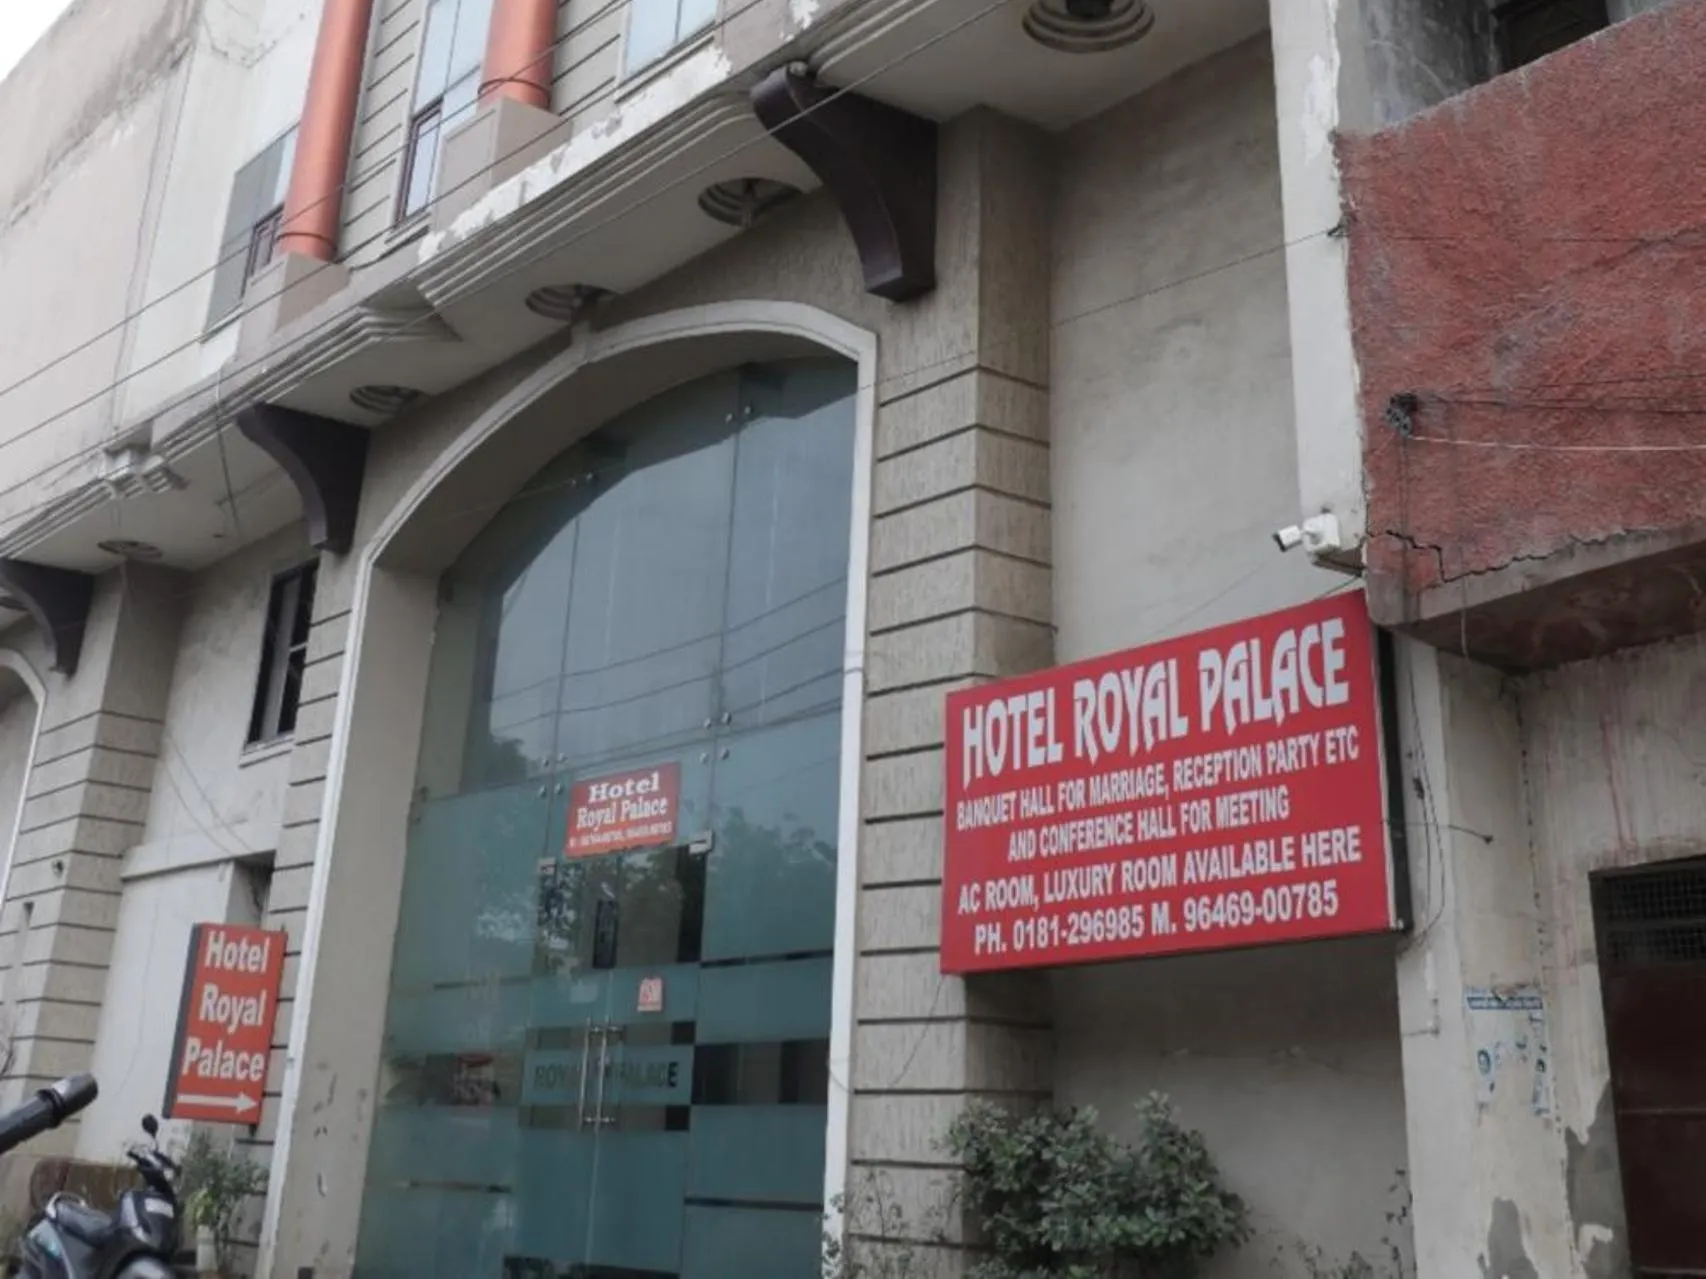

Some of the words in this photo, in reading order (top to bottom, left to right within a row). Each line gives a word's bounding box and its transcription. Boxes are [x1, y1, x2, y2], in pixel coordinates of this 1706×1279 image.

[962, 687, 1064, 790] HOTEL
[1073, 658, 1188, 766] ROYAL
[1199, 617, 1349, 736] PALACE
[588, 771, 660, 804] Hotel
[956, 790, 1017, 831] BANQUET
[1020, 785, 1054, 819] HALL
[1057, 778, 1086, 813] FOR
[1089, 763, 1169, 801] MARRIAGE,
[1173, 743, 1262, 793] RECEPTION
[1266, 732, 1320, 775] PARTY
[1324, 724, 1359, 764] ETC
[576, 801, 617, 832] Royal
[620, 796, 668, 822] Palace
[1007, 828, 1036, 862] AND
[1039, 811, 1133, 858] CONFERENCE
[1137, 804, 1177, 843] HALL
[1180, 797, 1212, 836] FOR
[1215, 784, 1290, 830] MEETING
[957, 882, 981, 916] AC
[984, 873, 1040, 912] ROOM,
[1043, 862, 1117, 903] LUXURY
[1120, 852, 1178, 893] ROOM
[1183, 835, 1296, 885] AVAILABLE
[1301, 825, 1363, 869] HERE
[974, 921, 1008, 956] PH.
[1013, 903, 1145, 951] 0181-296985
[1151, 900, 1178, 937] M.
[1183, 878, 1339, 933] 96469-00785
[204, 930, 271, 974] Hotel
[199, 983, 267, 1034] Royal
[182, 1037, 264, 1082] Palace
